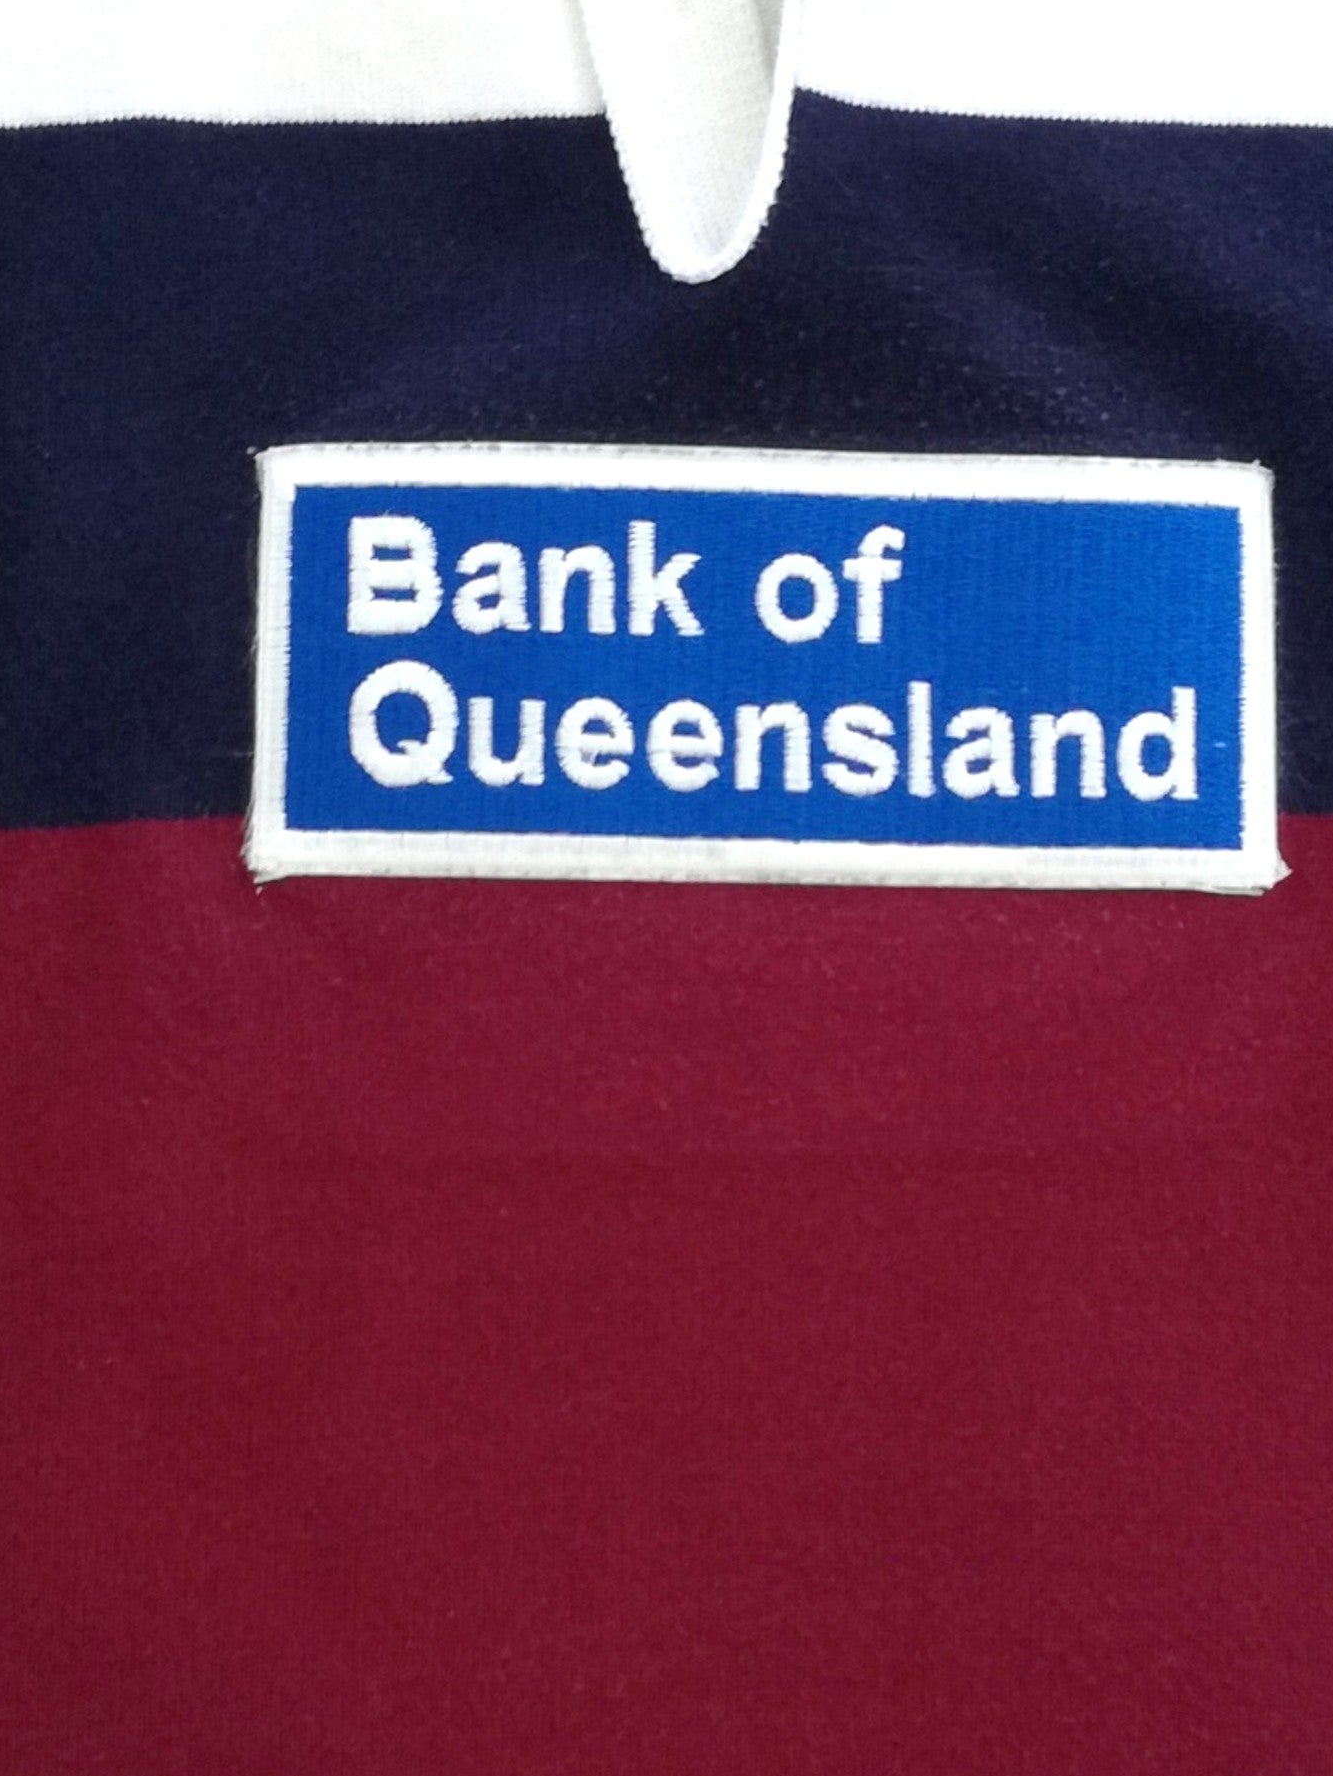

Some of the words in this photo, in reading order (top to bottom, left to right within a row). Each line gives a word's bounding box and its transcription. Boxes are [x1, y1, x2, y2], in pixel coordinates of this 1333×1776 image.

[346, 514, 705, 637] Bank
[755, 525, 906, 644] of
[349, 659, 1198, 802] Queensland
